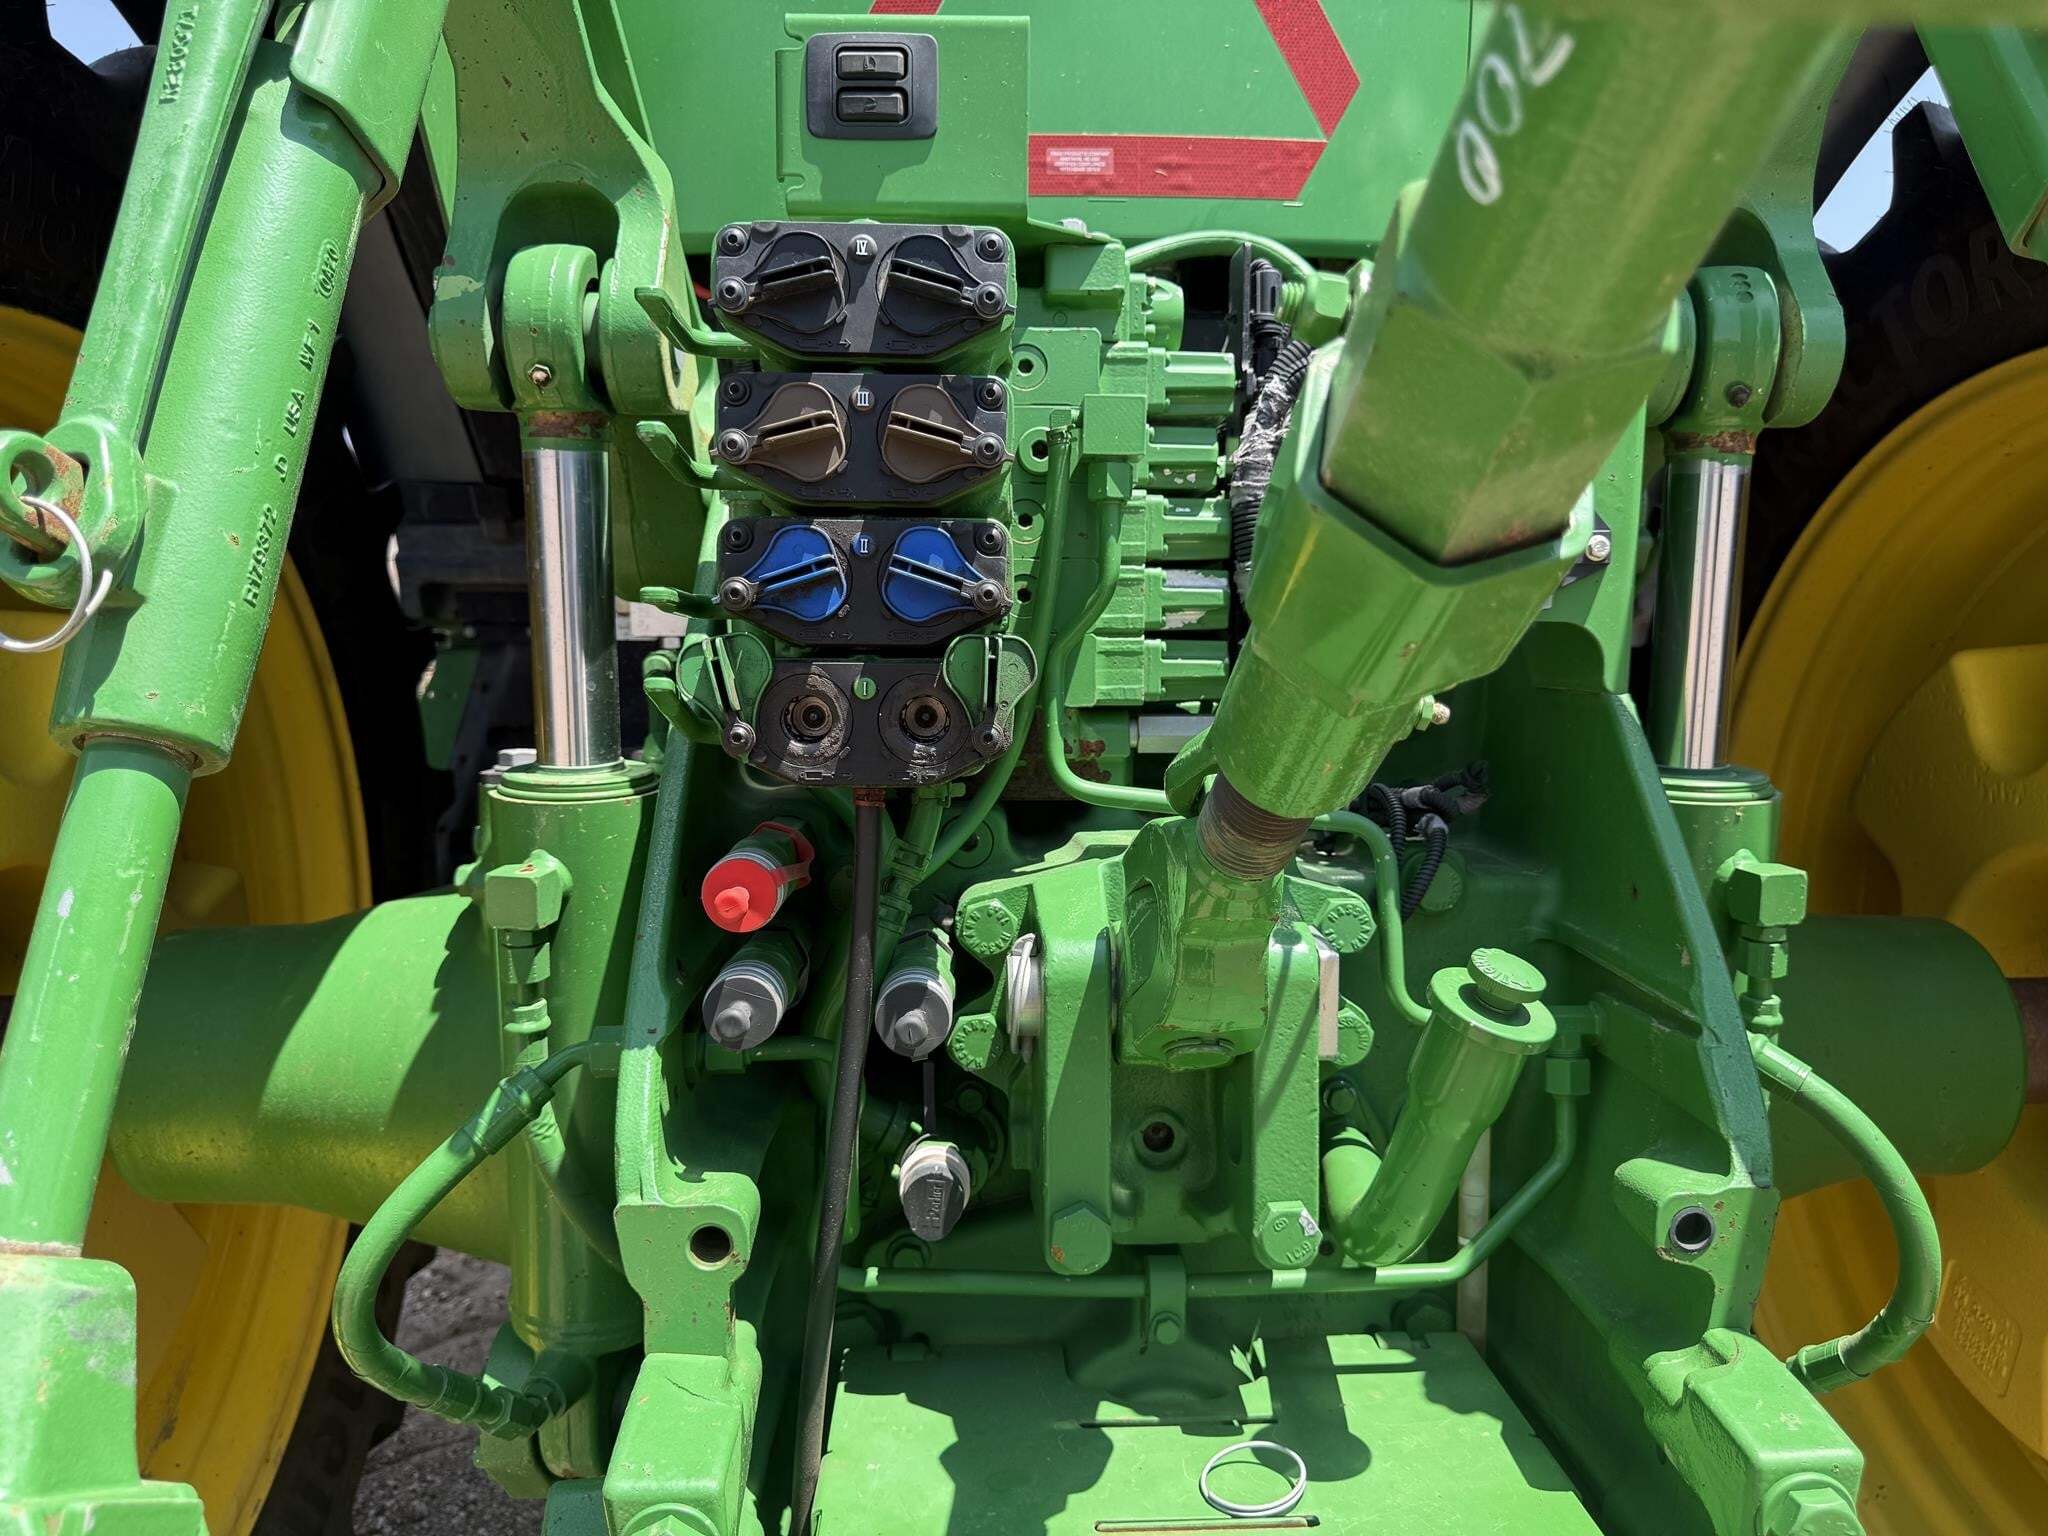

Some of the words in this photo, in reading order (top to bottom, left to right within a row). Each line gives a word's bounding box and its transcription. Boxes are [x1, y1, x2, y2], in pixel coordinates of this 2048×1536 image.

[855, 239, 868, 256] IV
[857, 391, 870, 407] III
[283, 389, 305, 438] USA
[860, 538, 868, 553] II
